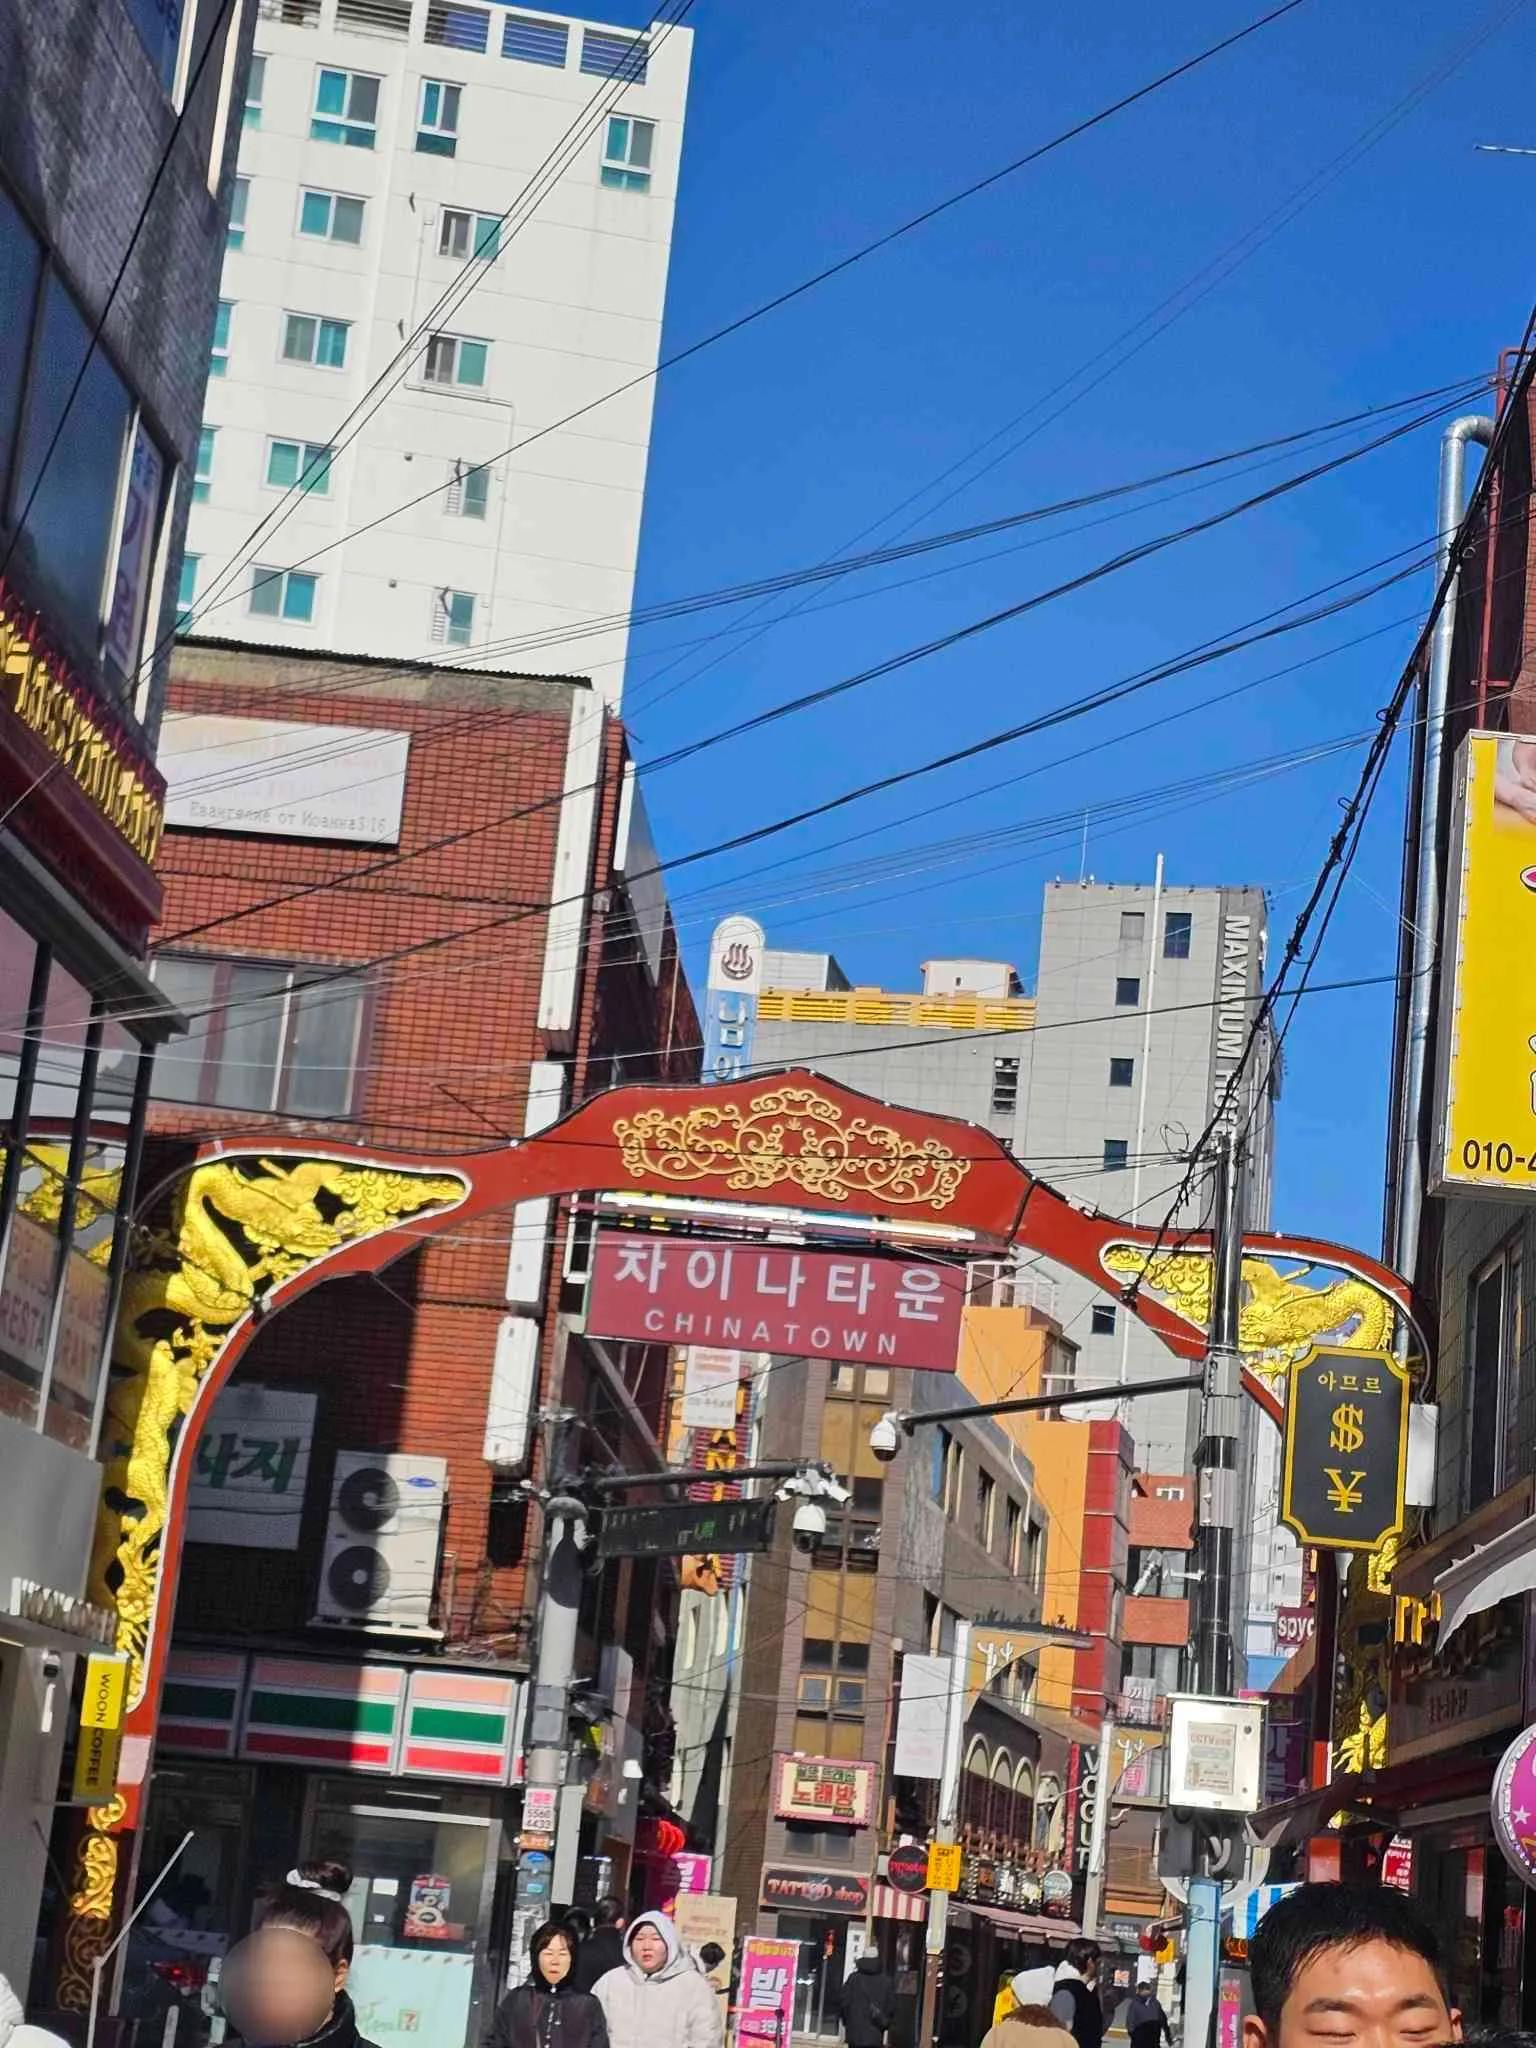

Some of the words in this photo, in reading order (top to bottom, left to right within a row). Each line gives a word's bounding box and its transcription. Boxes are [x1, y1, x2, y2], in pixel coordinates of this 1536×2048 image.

[1215, 914, 1251, 1061] MAXIMUM
[613, 1240, 946, 1322] 차이나타운
[643, 1308, 899, 1356] CHINATOWN
[1317, 1370, 1382, 1394] 아므르
[95, 1673, 112, 1723] WOON
[86, 1728, 105, 1787] COFFEE
[793, 1782, 857, 1806] 노래방
[835, 1884, 865, 1905] shop
